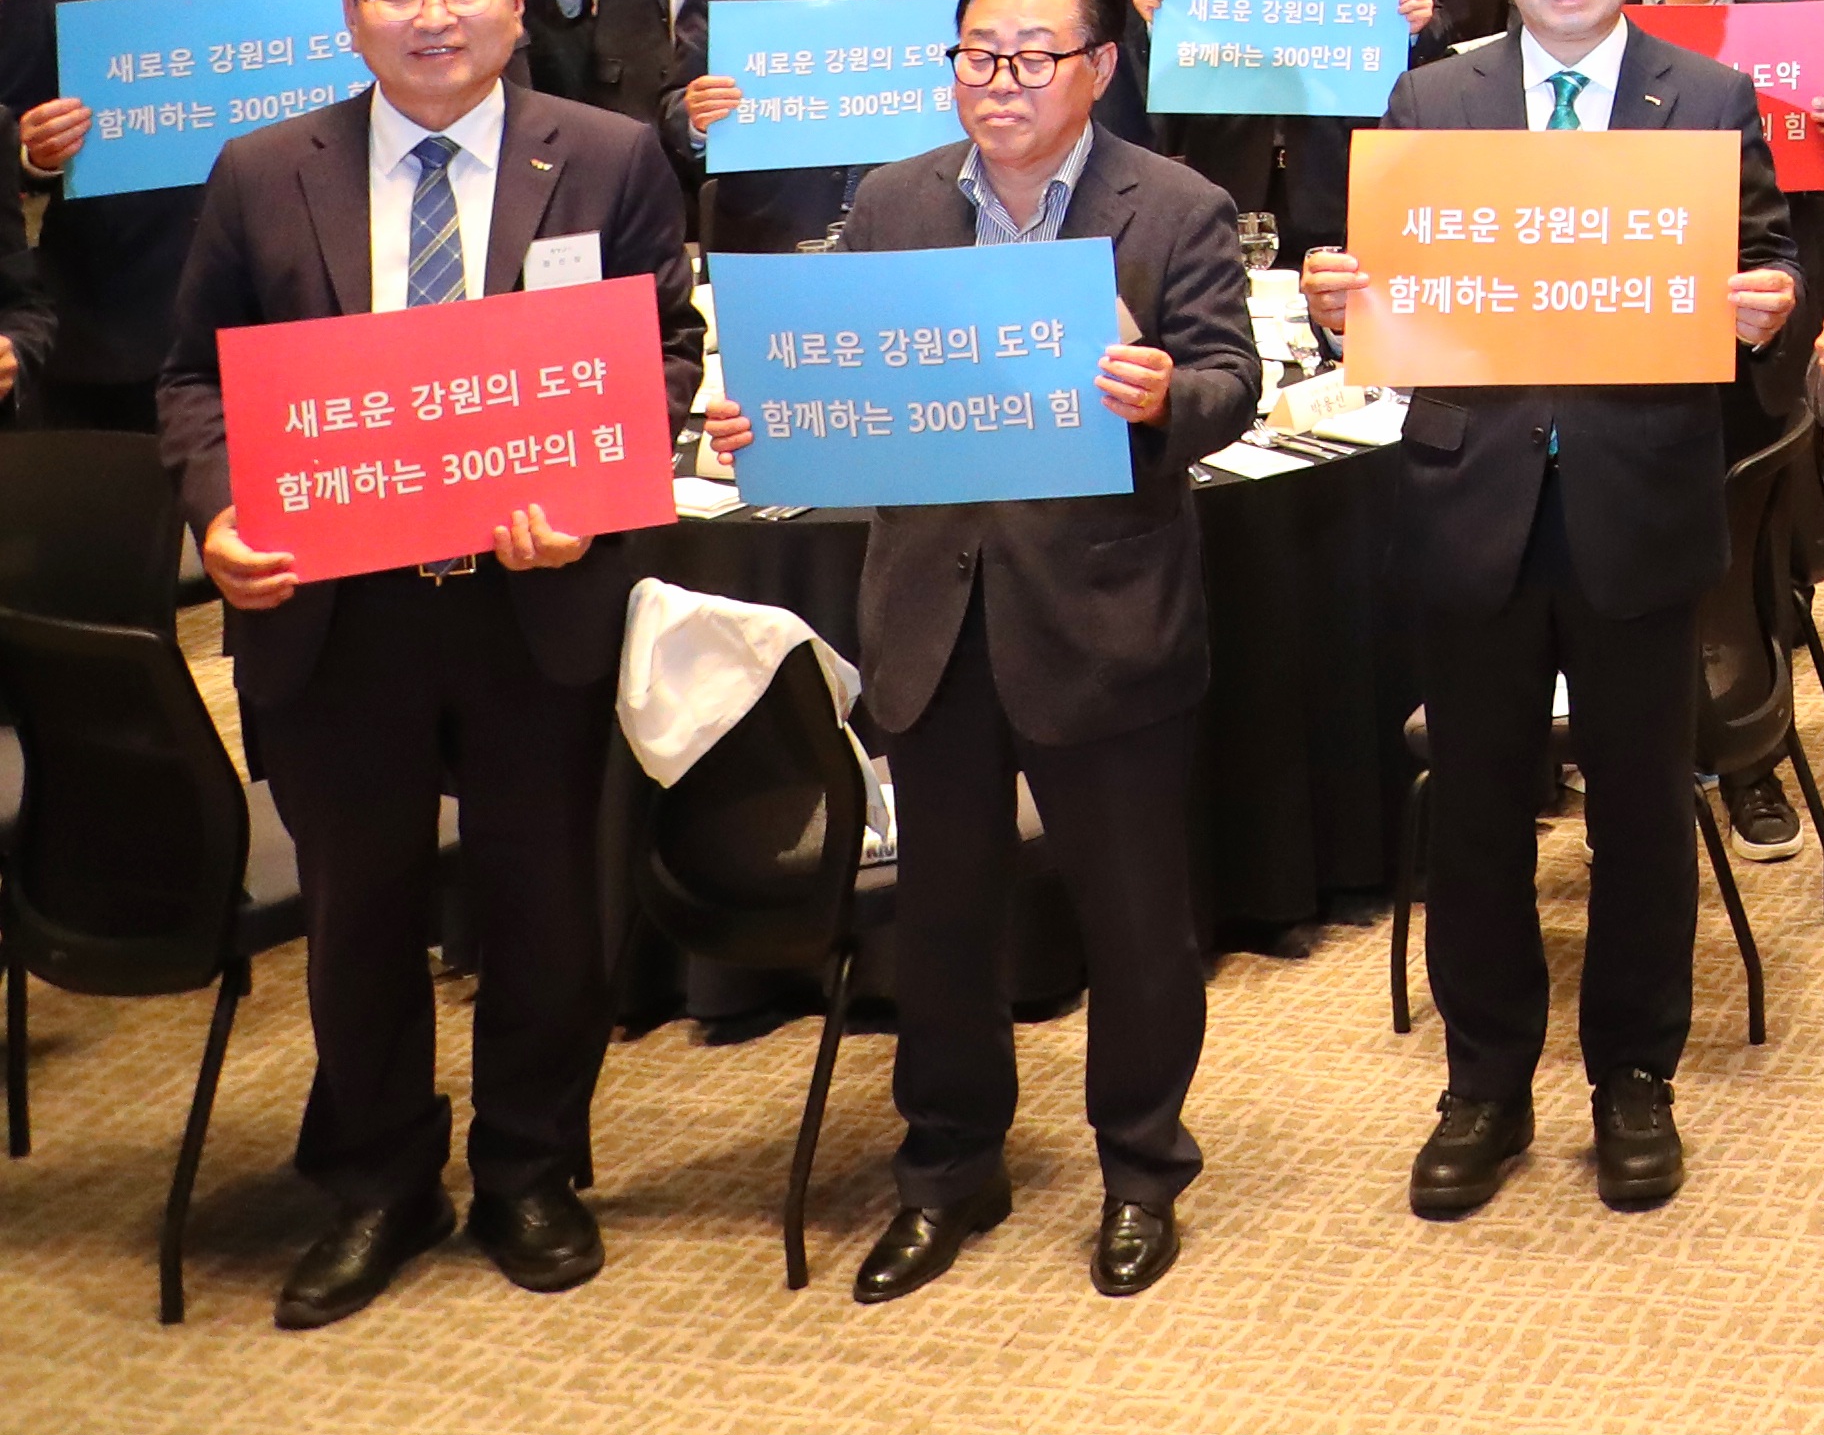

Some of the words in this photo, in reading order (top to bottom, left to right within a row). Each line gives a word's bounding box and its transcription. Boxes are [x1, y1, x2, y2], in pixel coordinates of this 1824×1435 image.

[1262, 0, 1324, 25] 강원의
[1333, 4, 1376, 27] 도약
[106, 48, 196, 83] 새로운
[208, 37, 293, 72] 강원의
[743, 51, 815, 76] 새로운
[825, 46, 892, 72] 강원의
[1179, 43, 1264, 67] 함께하는
[1271, 45, 1351, 70] 300만의
[1362, 47, 1380, 71] 힘
[96, 101, 216, 139] 함께하는
[734, 87, 829, 123] 함께하는
[838, 88, 922, 117] 300만의
[1402, 207, 1502, 244] 새로운
[1514, 206, 1609, 244] 강원의
[1623, 207, 1688, 245] 도약
[1389, 275, 1521, 314] 함께하는
[1532, 276, 1652, 314] 300만의
[1667, 275, 1697, 313] 힘
[766, 331, 864, 368] 새로운
[879, 325, 978, 366] 강원의
[995, 319, 1063, 357] 도약
[285, 391, 395, 437] 새로운
[412, 370, 519, 421] 강원의
[537, 358, 606, 398] 도약
[761, 400, 893, 438] 함께하는
[907, 392, 1033, 432] 300만의
[1048, 389, 1079, 427] 힘
[276, 459, 426, 512] 함께하는
[442, 430, 576, 485] 300만의
[592, 423, 624, 462] 힘
